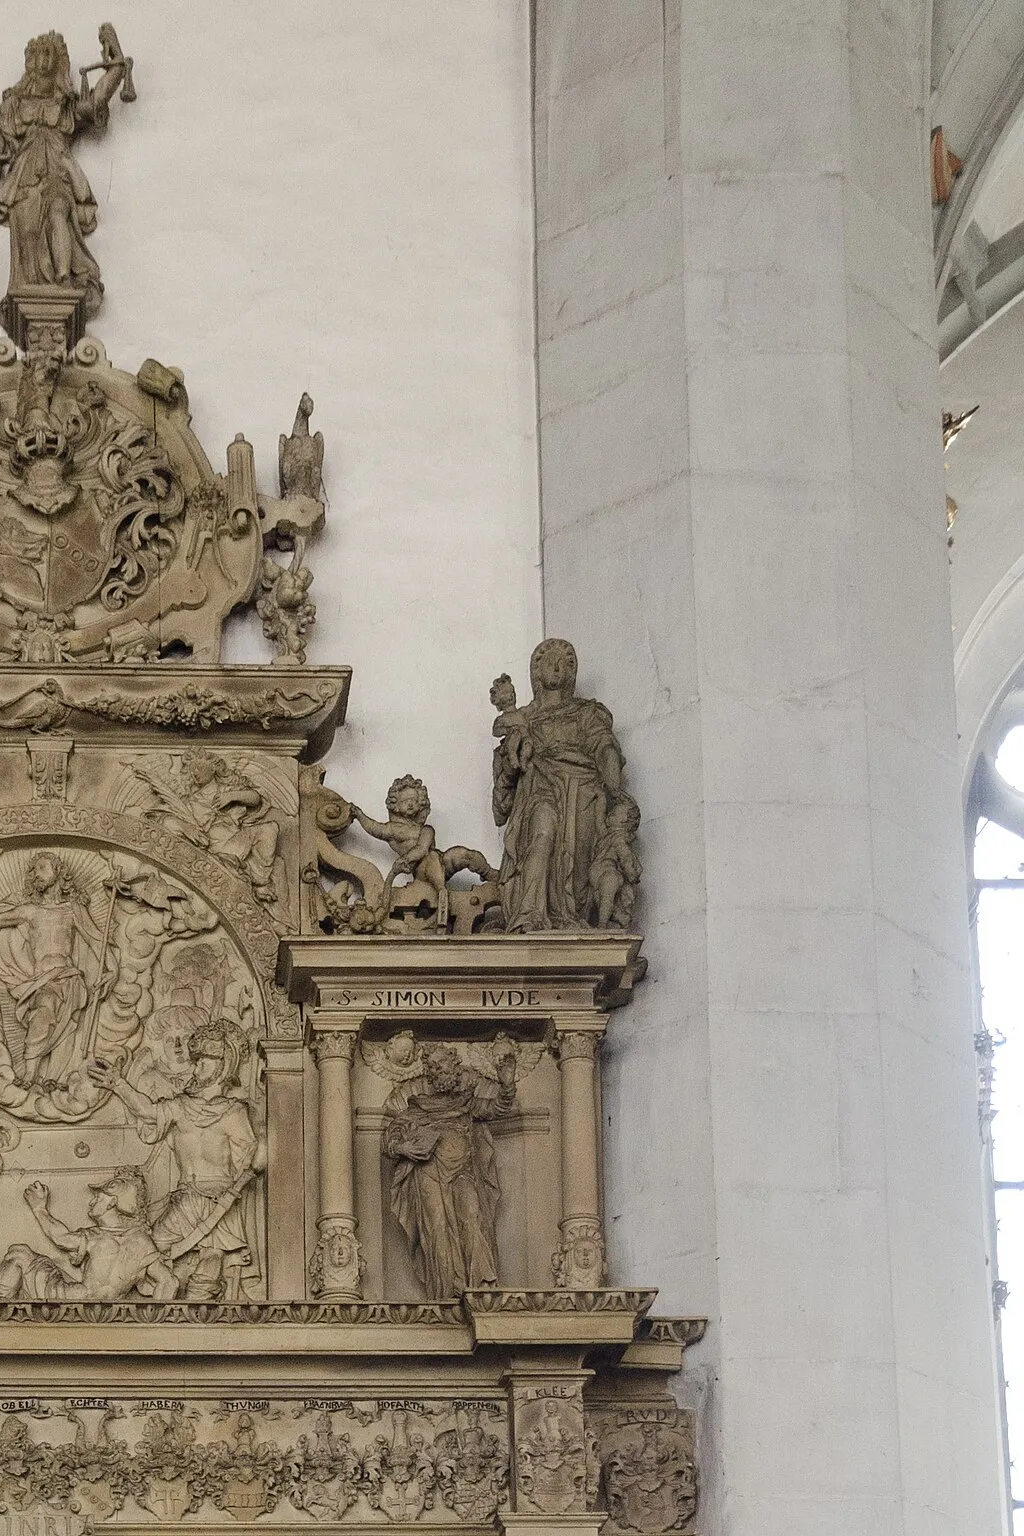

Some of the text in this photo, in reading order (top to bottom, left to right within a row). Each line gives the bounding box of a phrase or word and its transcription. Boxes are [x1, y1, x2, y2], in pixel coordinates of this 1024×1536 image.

[371, 990, 446, 1007] SIMON
[481, 990, 541, 1006] IVDE
[536, 1387, 567, 1398] KLEE
[70, 1399, 109, 1407] ECHTER
[626, 1410, 667, 1423] RVD
